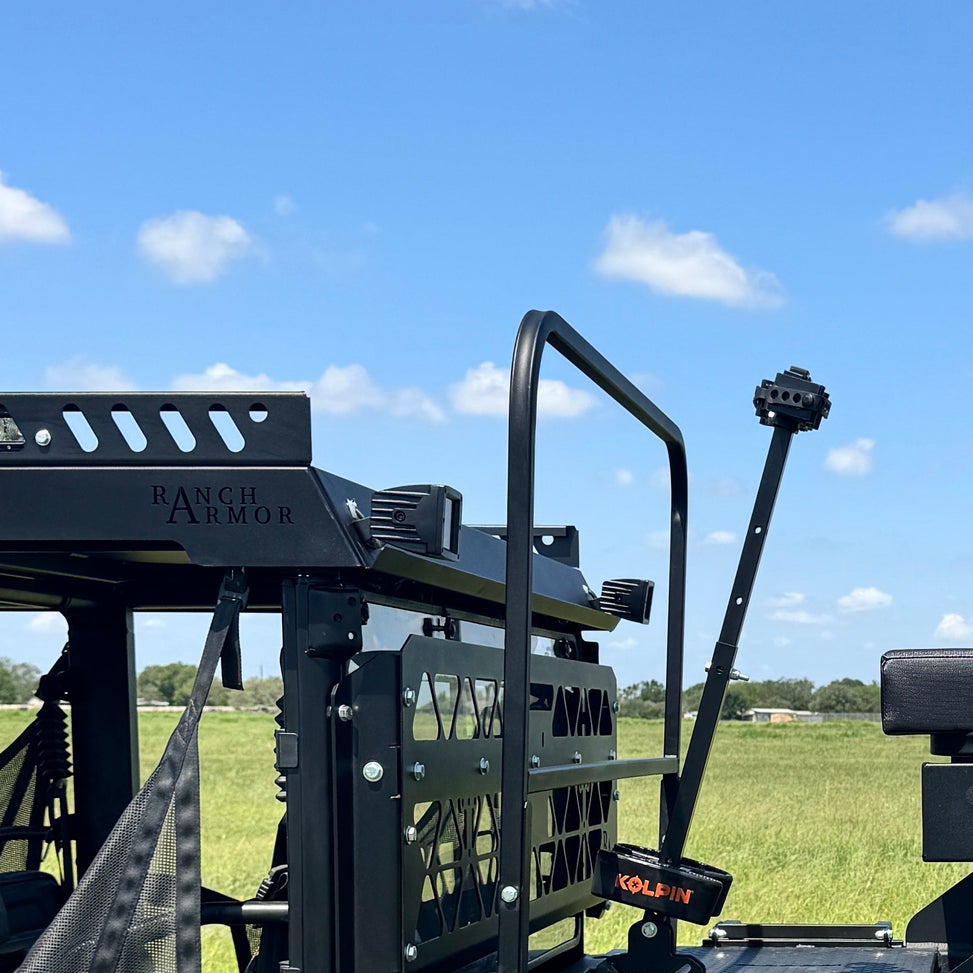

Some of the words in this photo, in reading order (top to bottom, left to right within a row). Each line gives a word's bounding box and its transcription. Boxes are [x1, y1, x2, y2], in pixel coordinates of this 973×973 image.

[151, 485, 257, 524] RANCH
[166, 485, 294, 524] ARMOR
[614, 873, 693, 905] KOLPIN
